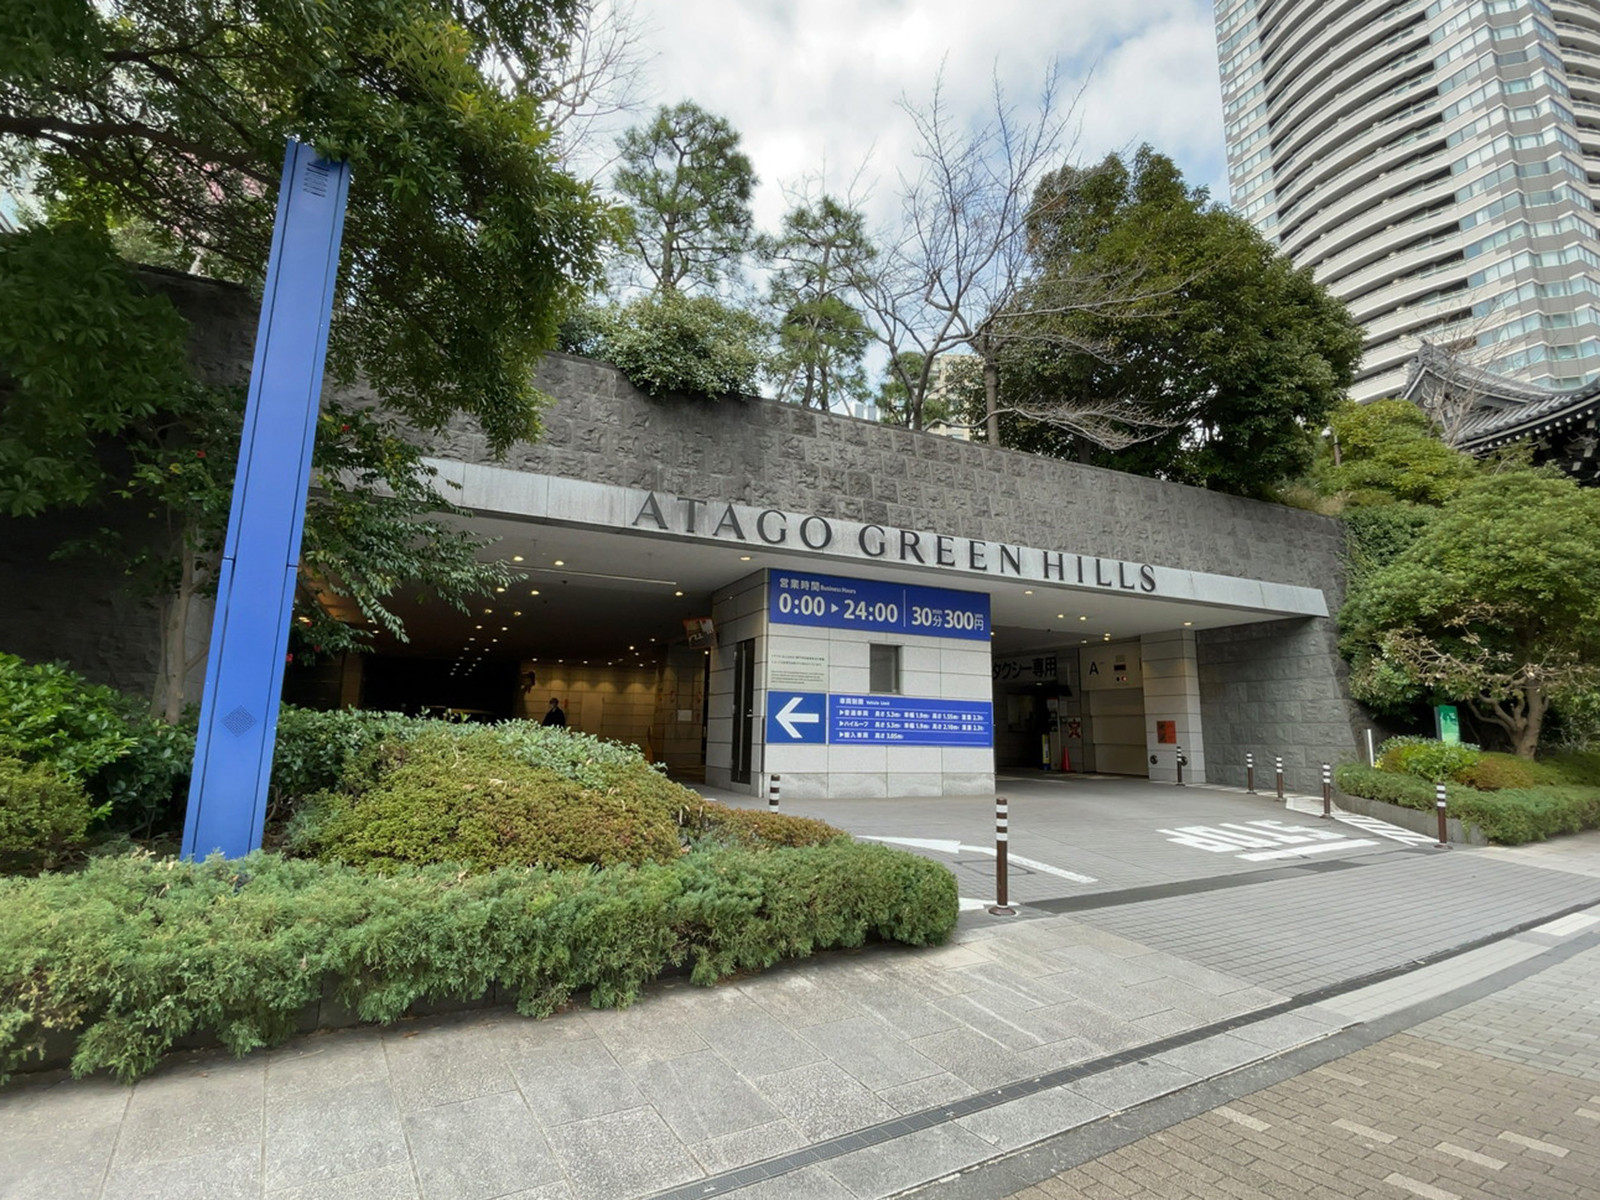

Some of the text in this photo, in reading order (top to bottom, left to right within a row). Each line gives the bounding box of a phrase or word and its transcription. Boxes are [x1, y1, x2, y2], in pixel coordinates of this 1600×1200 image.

[632, 491, 1156, 593] ATAGO GREEN HILLS
[779, 578, 820, 591] 営業時間
[779, 593, 898, 623] 0:00 24:00
[1089, 662, 1099, 675] A
